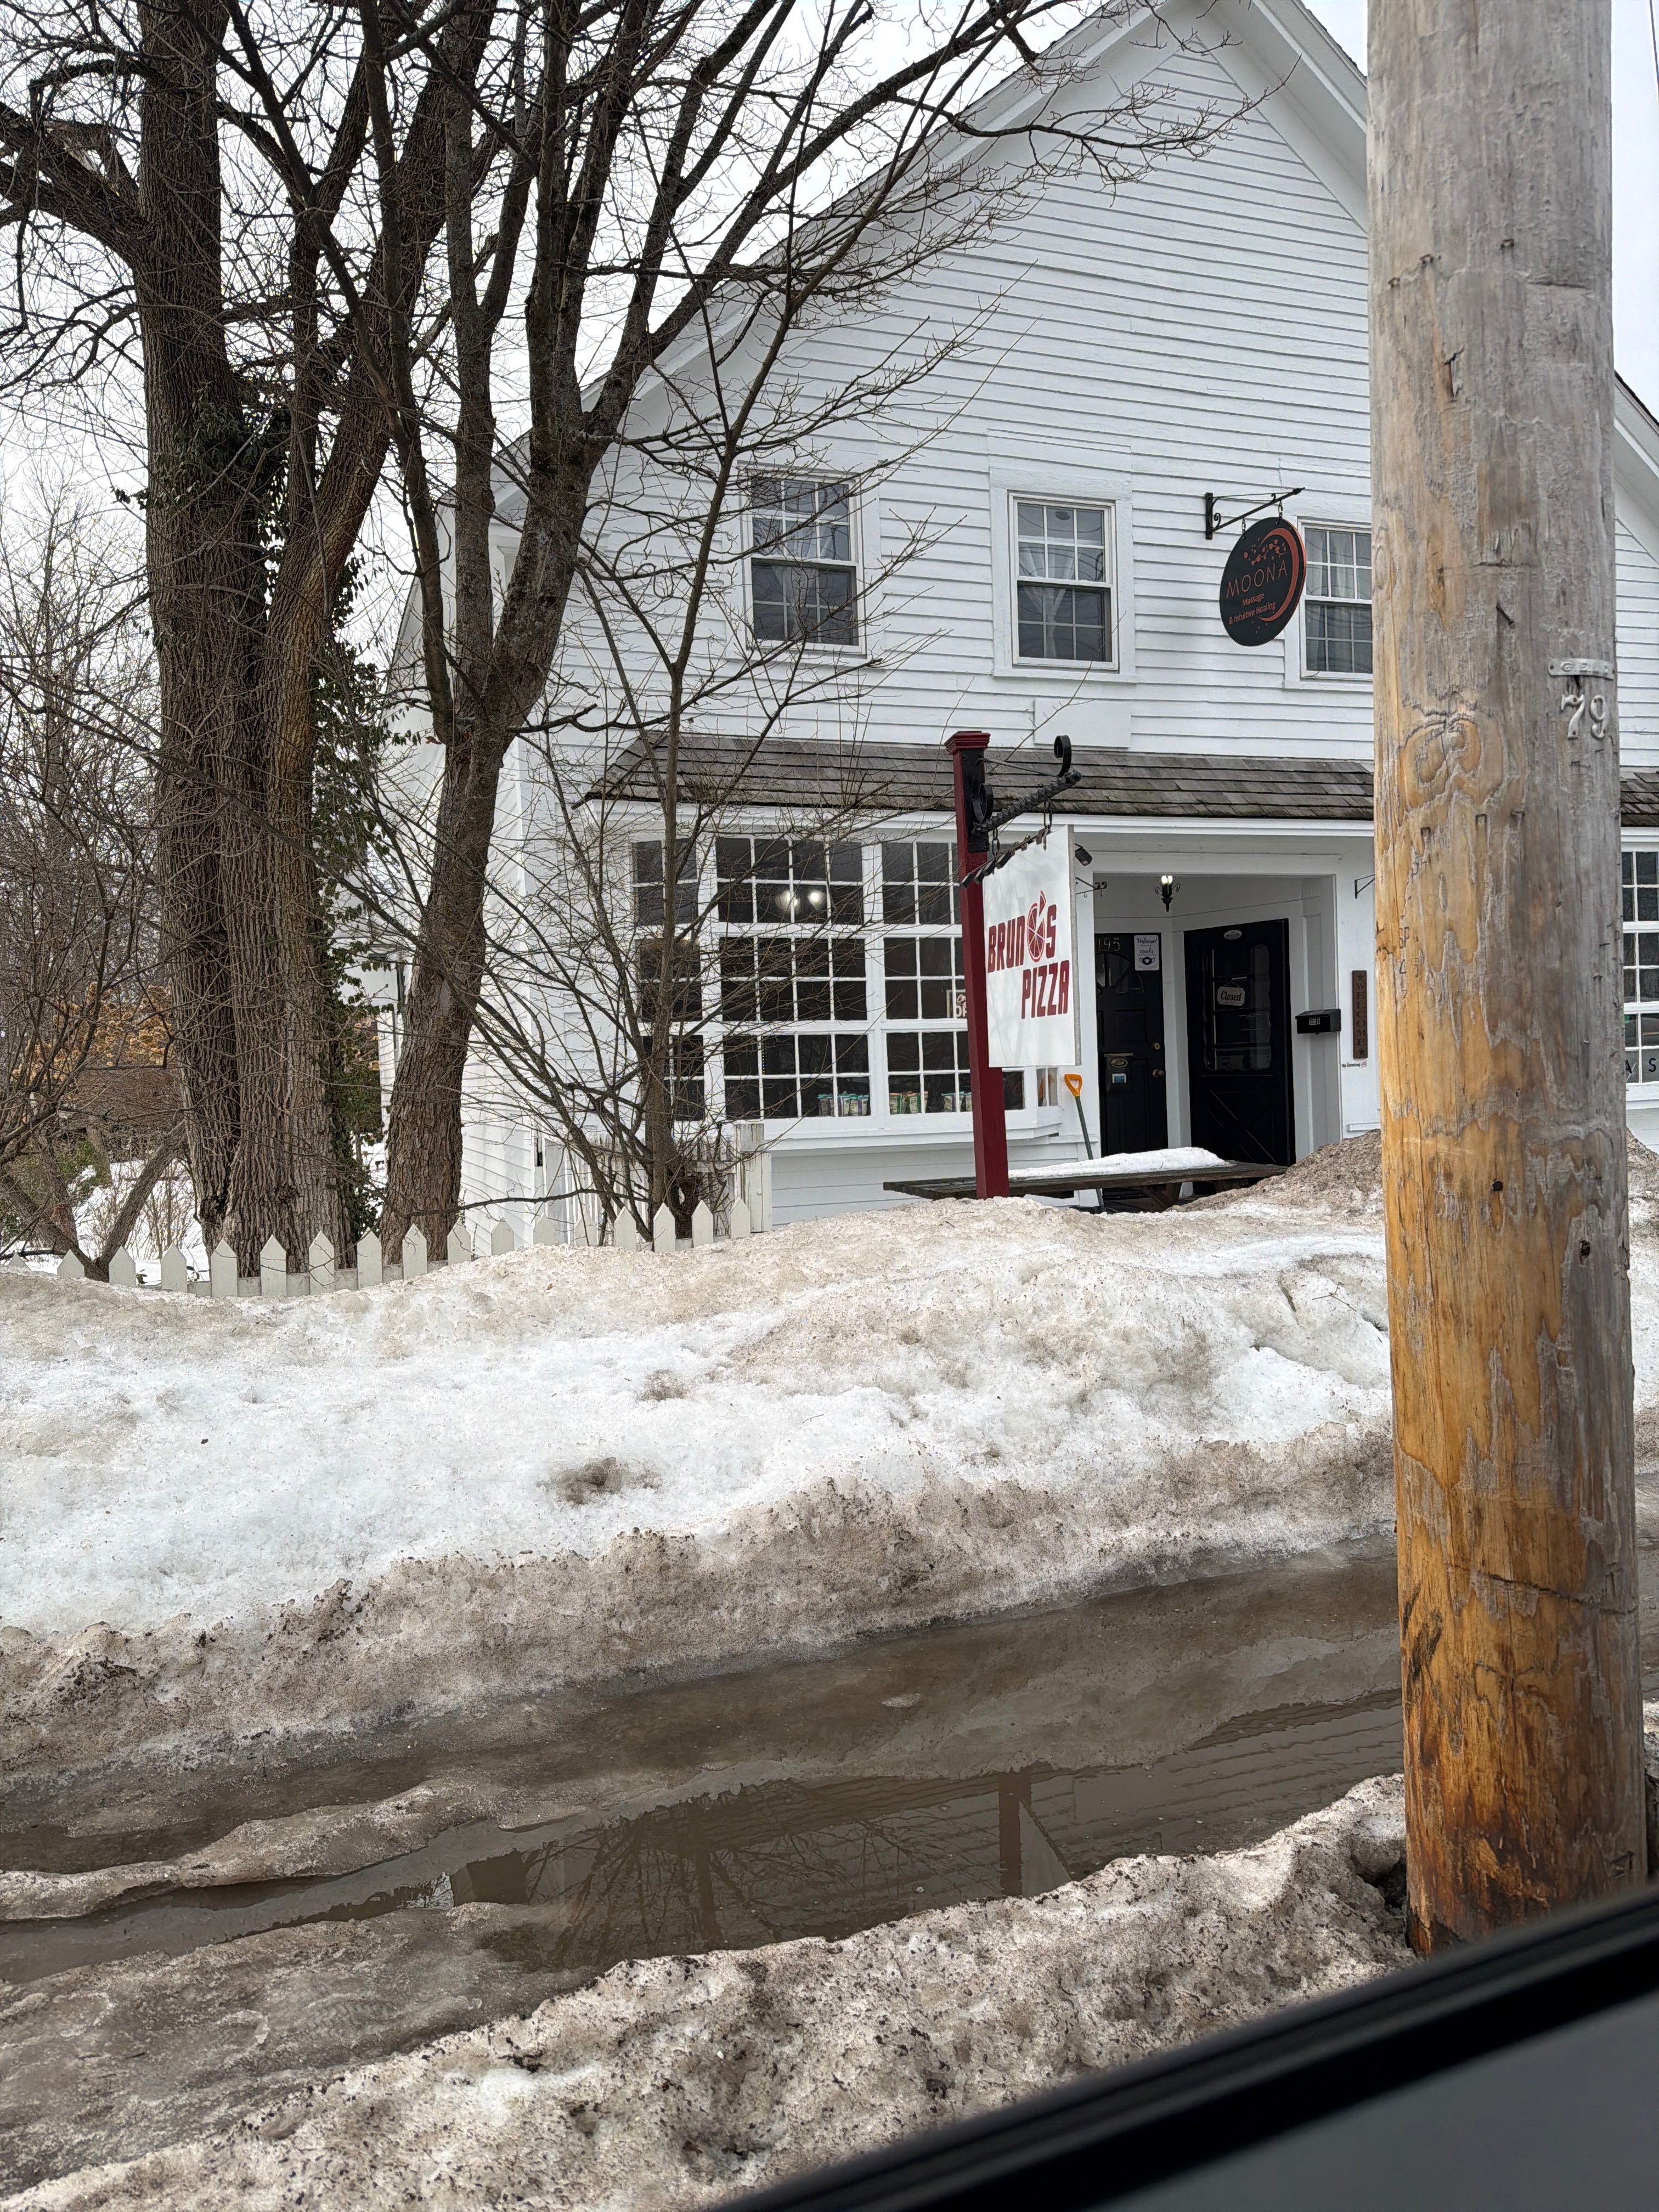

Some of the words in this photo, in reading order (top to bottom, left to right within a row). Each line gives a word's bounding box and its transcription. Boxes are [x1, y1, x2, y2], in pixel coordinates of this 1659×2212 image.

[1226, 560, 1287, 599] MOONA
[1228, 616, 1233, 624] &
[1234, 610, 1255, 623] Intuitive
[1256, 601, 1276, 614] Healing
[1242, 592, 1265, 606] Massage
[1560, 694, 1608, 740] 79
[1098, 937, 1121, 951] 195
[1021, 960, 1070, 1019] PIZZA
[1221, 991, 1242, 1001] Closed
[1356, 983, 1366, 1046] WELCOME
